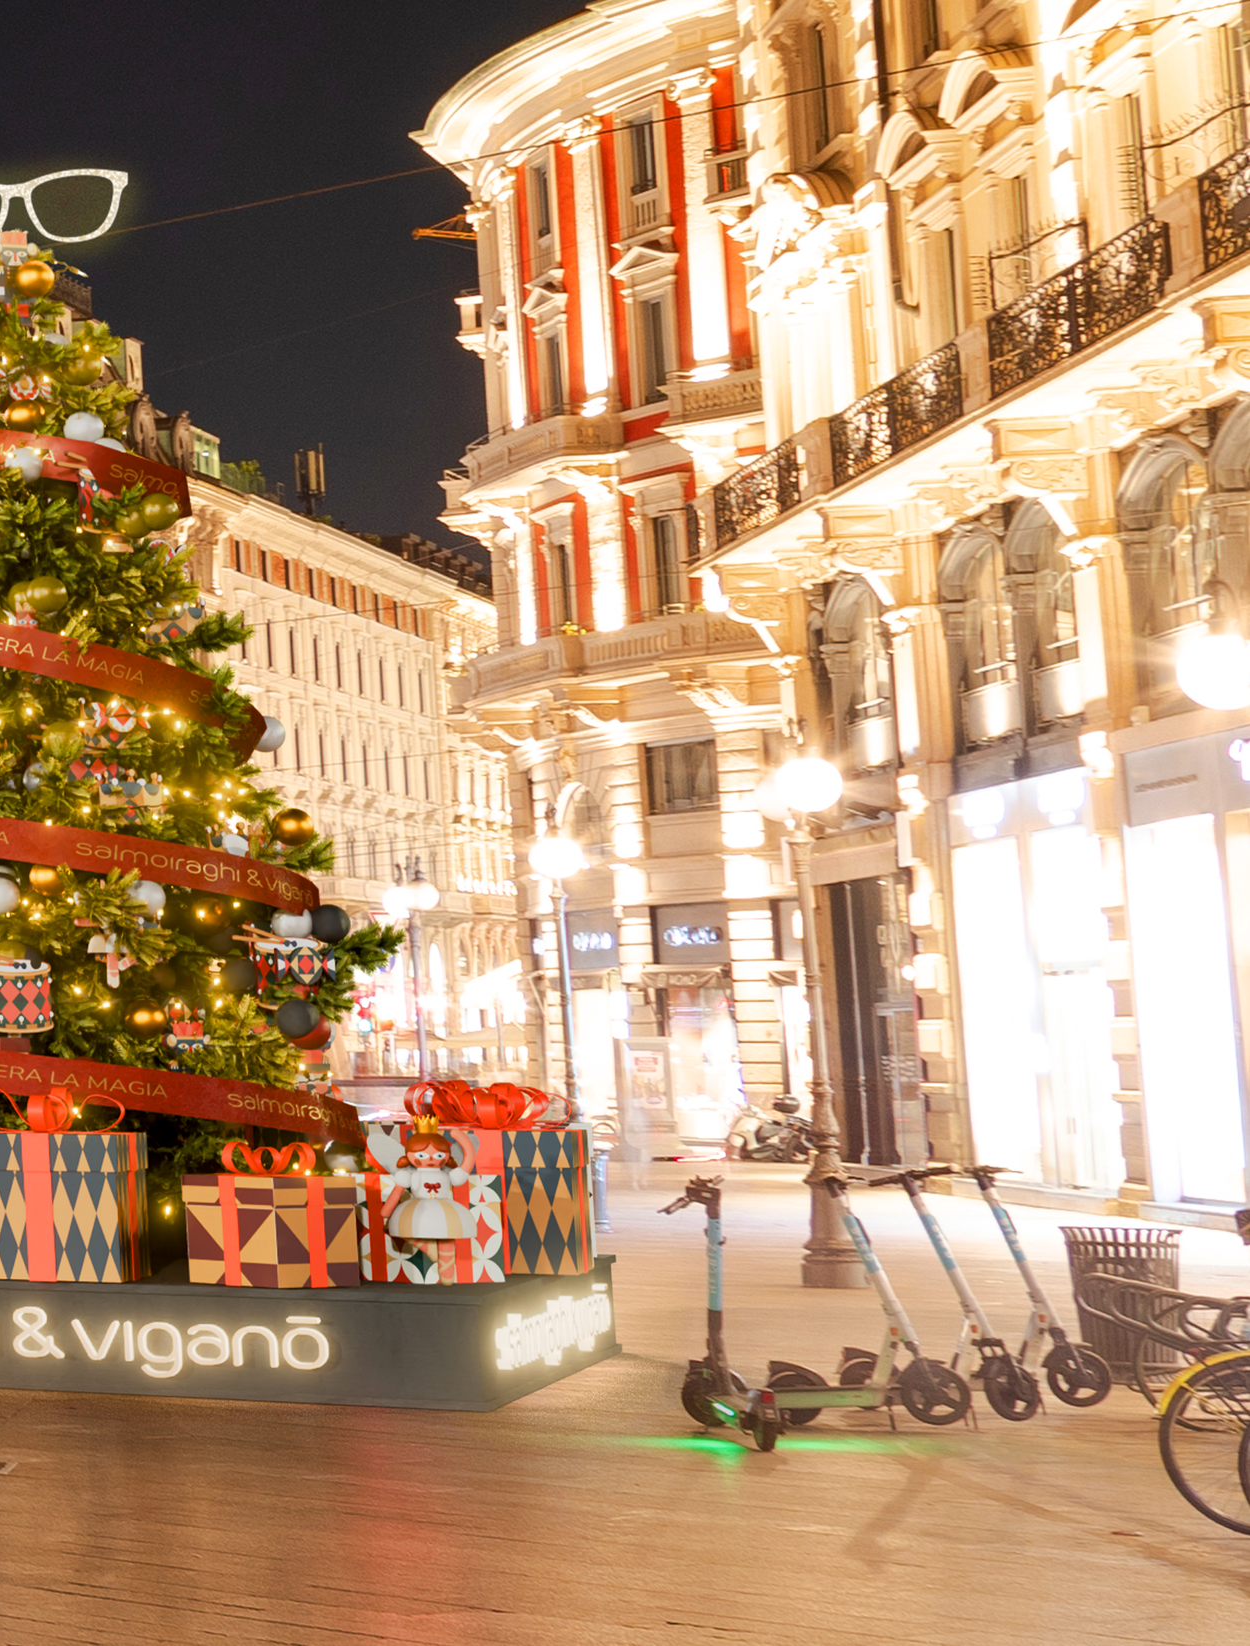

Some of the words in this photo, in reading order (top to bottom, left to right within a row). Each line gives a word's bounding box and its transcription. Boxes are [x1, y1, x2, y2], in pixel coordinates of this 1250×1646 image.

[42, 646, 69, 665] LA
[76, 655, 144, 684] MAGIA
[75, 841, 240, 882] salmoiraghi
[246, 868, 264, 888] &
[50, 1071, 80, 1087] LA
[88, 1075, 168, 1099] MAGIA
[12, 1305, 65, 1360] &
